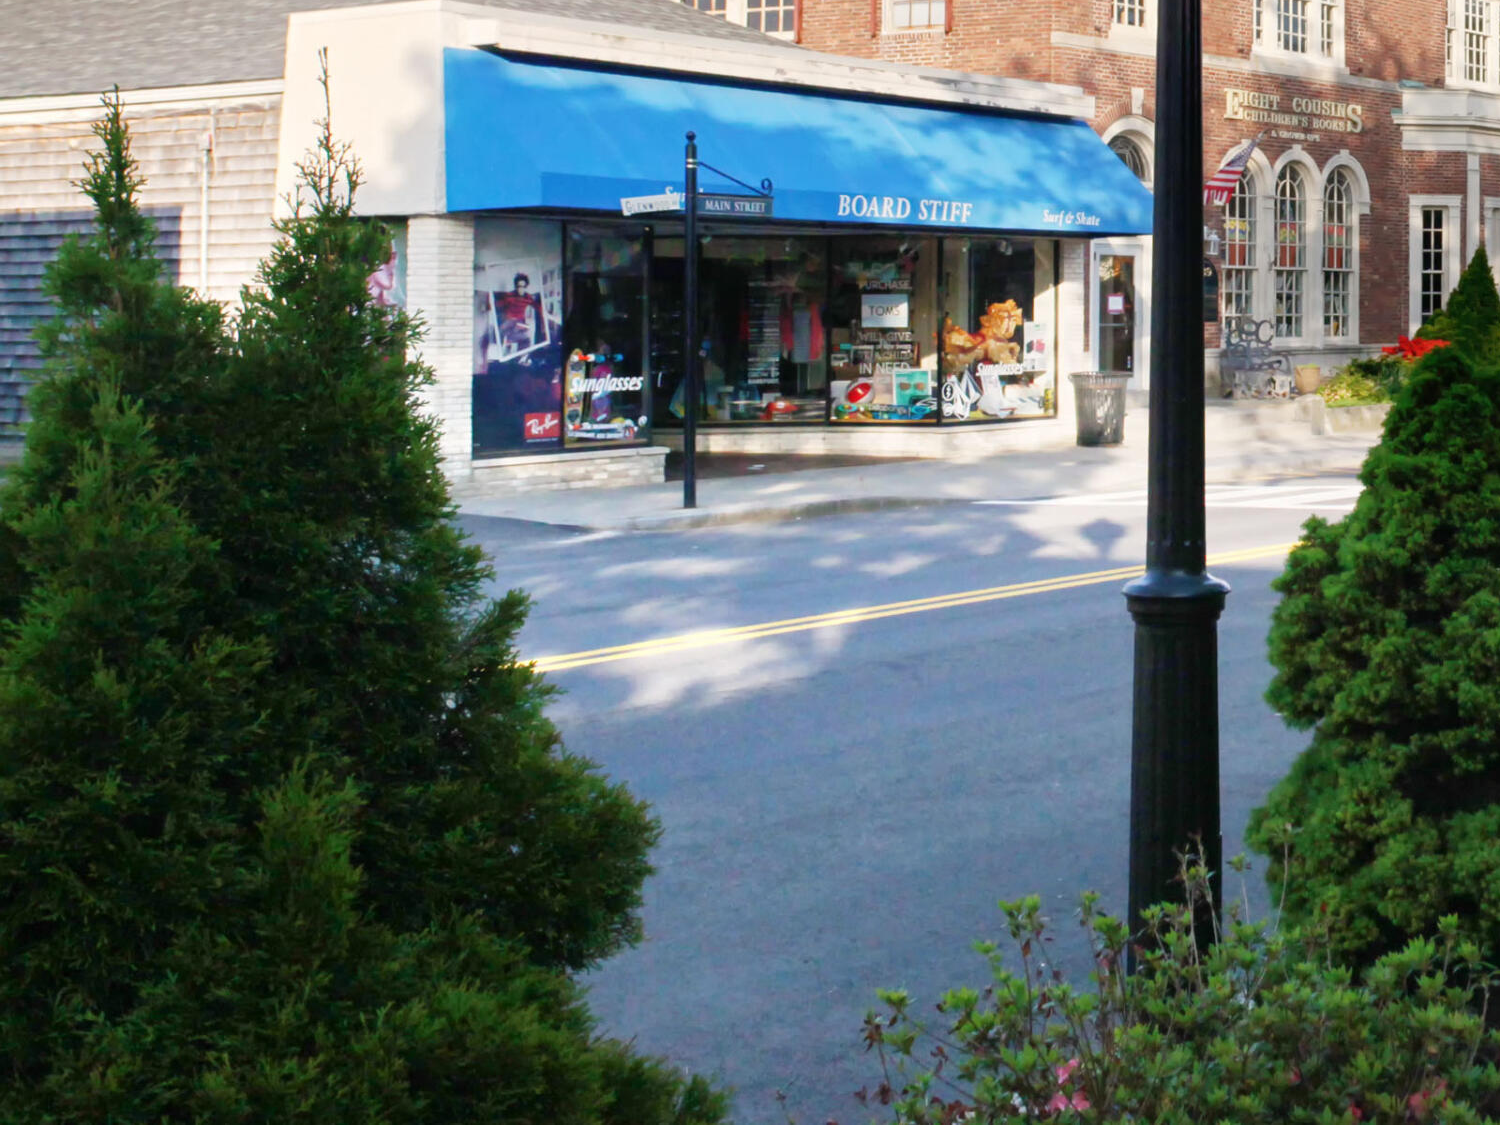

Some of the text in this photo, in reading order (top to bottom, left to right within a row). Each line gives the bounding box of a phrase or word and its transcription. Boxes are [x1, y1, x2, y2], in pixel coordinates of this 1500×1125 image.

[1224, 88, 1362, 133] EIGHT COUSINS
[1244, 110, 1345, 132] CHILDREN'S BOOKS
[705, 200, 766, 213] MAIN STREET
[838, 194, 973, 224] BOARD STIFF
[1042, 209, 1101, 227] Surf & Skate
[868, 305, 900, 317] TOMS
[886, 331, 912, 342] GIVE
[859, 362, 872, 374] IN
[570, 374, 644, 400] Sunglasses
